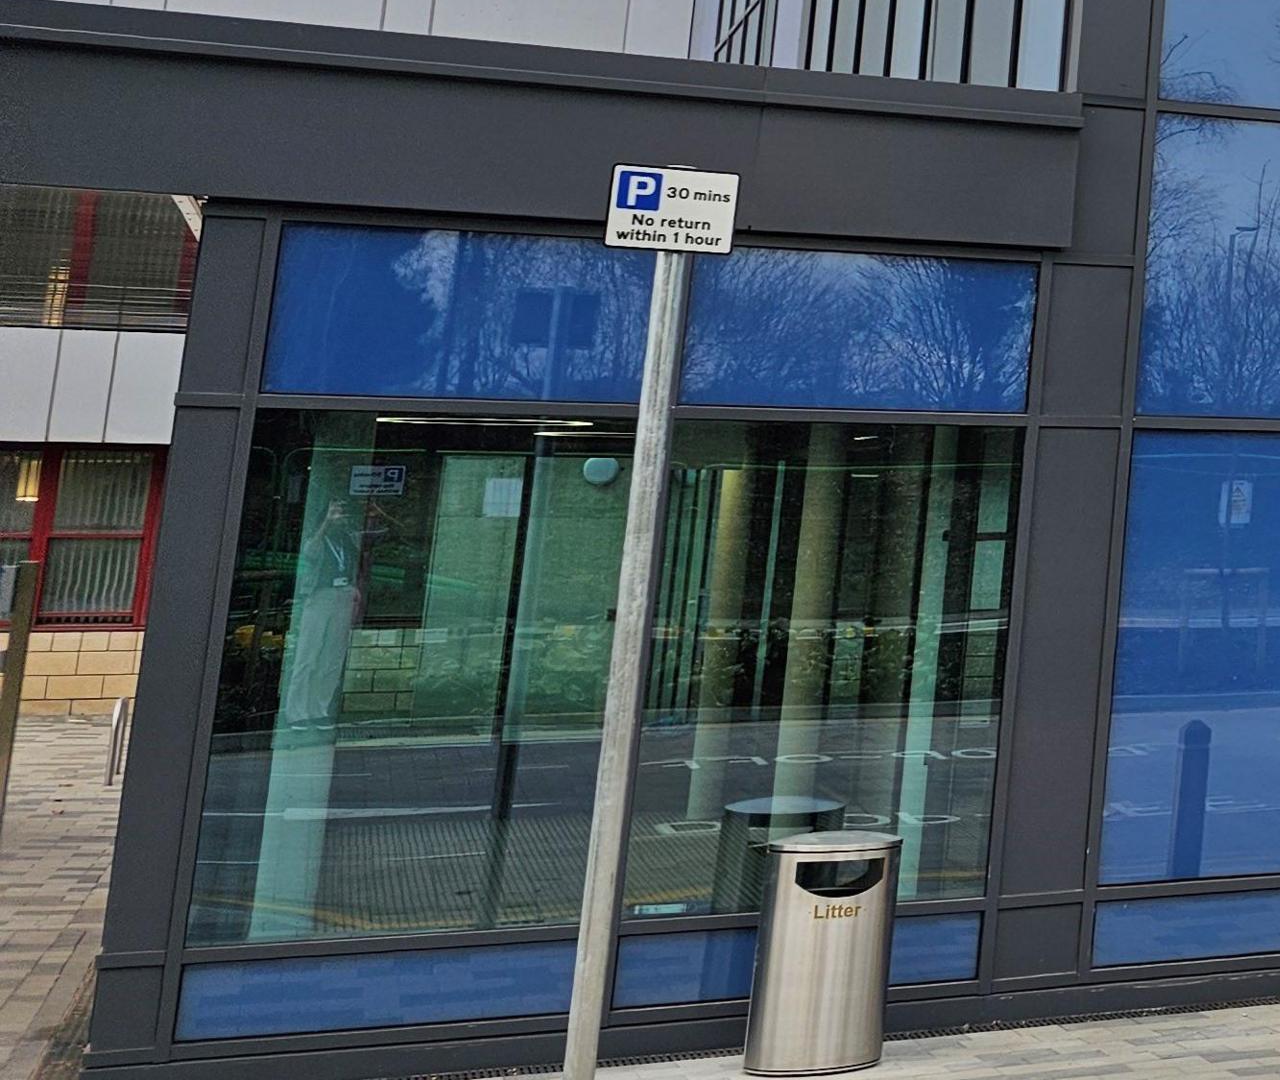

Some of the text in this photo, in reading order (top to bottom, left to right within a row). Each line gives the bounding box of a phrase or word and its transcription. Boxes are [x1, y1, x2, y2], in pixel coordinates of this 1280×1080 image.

[626, 175, 731, 207] P 30 mins
[631, 214, 711, 231] No return
[616, 229, 722, 247] within 1 hour
[814, 904, 862, 920] Litter
